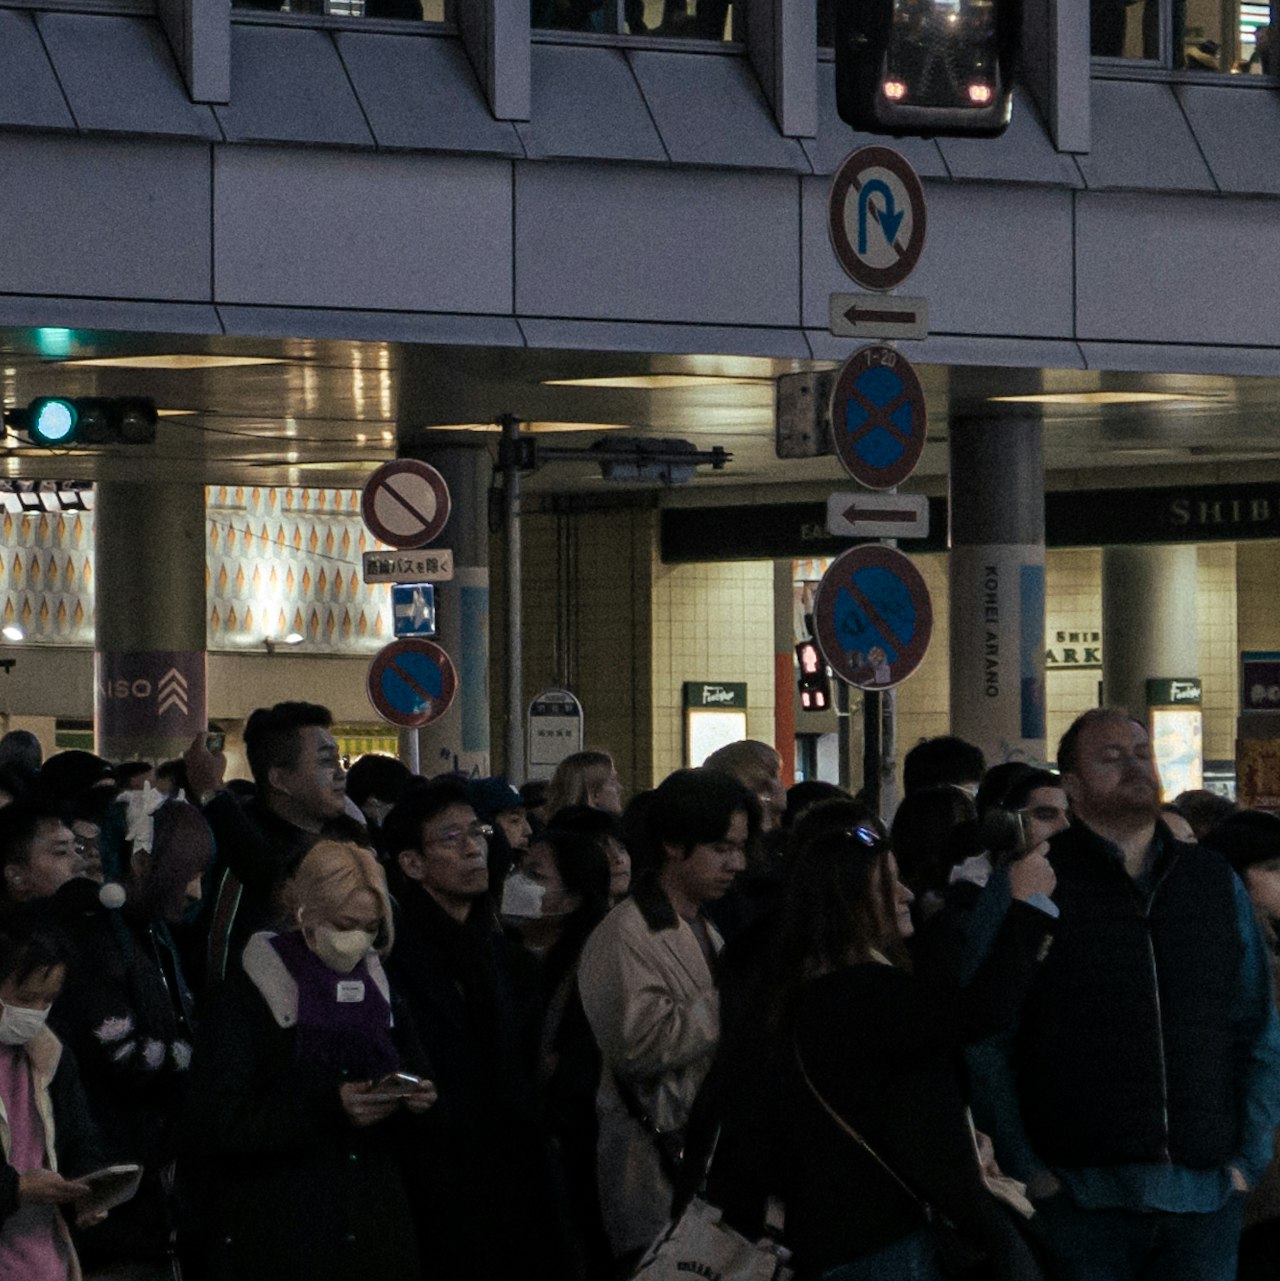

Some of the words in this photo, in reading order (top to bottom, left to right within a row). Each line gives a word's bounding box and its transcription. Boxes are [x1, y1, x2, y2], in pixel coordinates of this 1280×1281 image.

[864, 350, 897, 367] 7-20
[801, 523, 831, 541] EA
[985, 566, 999, 624] KOHEI
[1056, 631, 1100, 643] SHIB
[1046, 647, 1102, 663] ARK
[985, 632, 999, 698] ARANO
[99, 678, 152, 699] ISO
